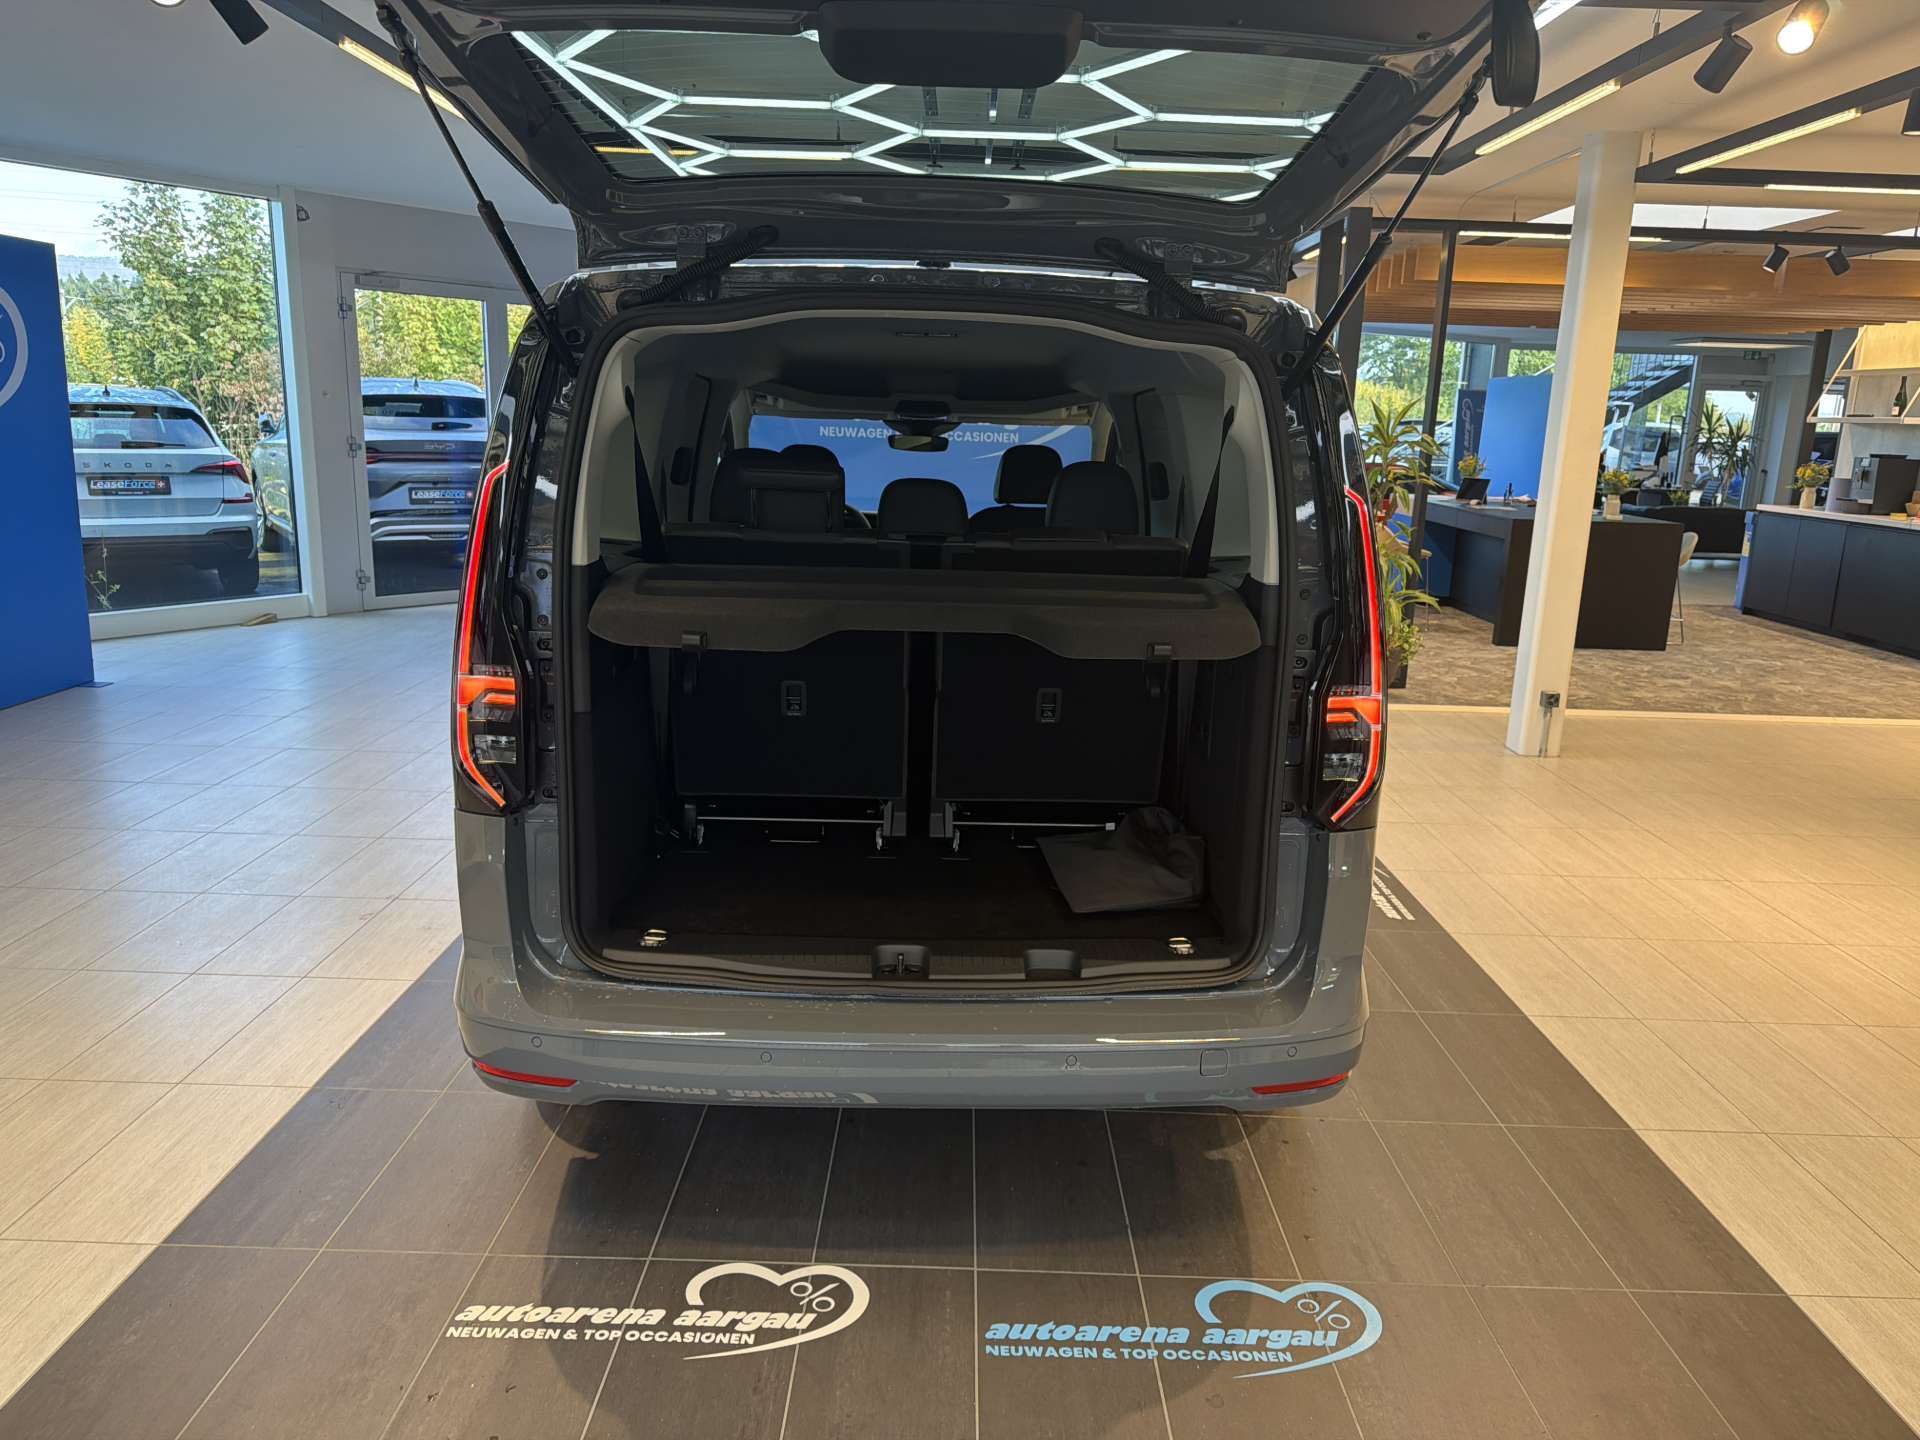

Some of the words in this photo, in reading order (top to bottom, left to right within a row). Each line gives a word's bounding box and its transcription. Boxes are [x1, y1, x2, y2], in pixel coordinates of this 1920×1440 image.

[90, 480, 155, 489] LeaseForce
[454, 1302, 667, 1326] autoarena
[672, 1309, 818, 1332] aargau
[445, 1326, 561, 1340] NEUWAGEN
[562, 1329, 579, 1341] &
[583, 1329, 622, 1341] TOP
[624, 1330, 756, 1345] OCCASIONEN
[984, 1320, 1191, 1344] autoarena
[1202, 1327, 1339, 1350] aargau
[985, 1344, 1099, 1359] NEUWAGEN
[1101, 1347, 1118, 1360] &
[1119, 1348, 1159, 1360] TOP
[1162, 1349, 1293, 1363] OCCASIONEN
